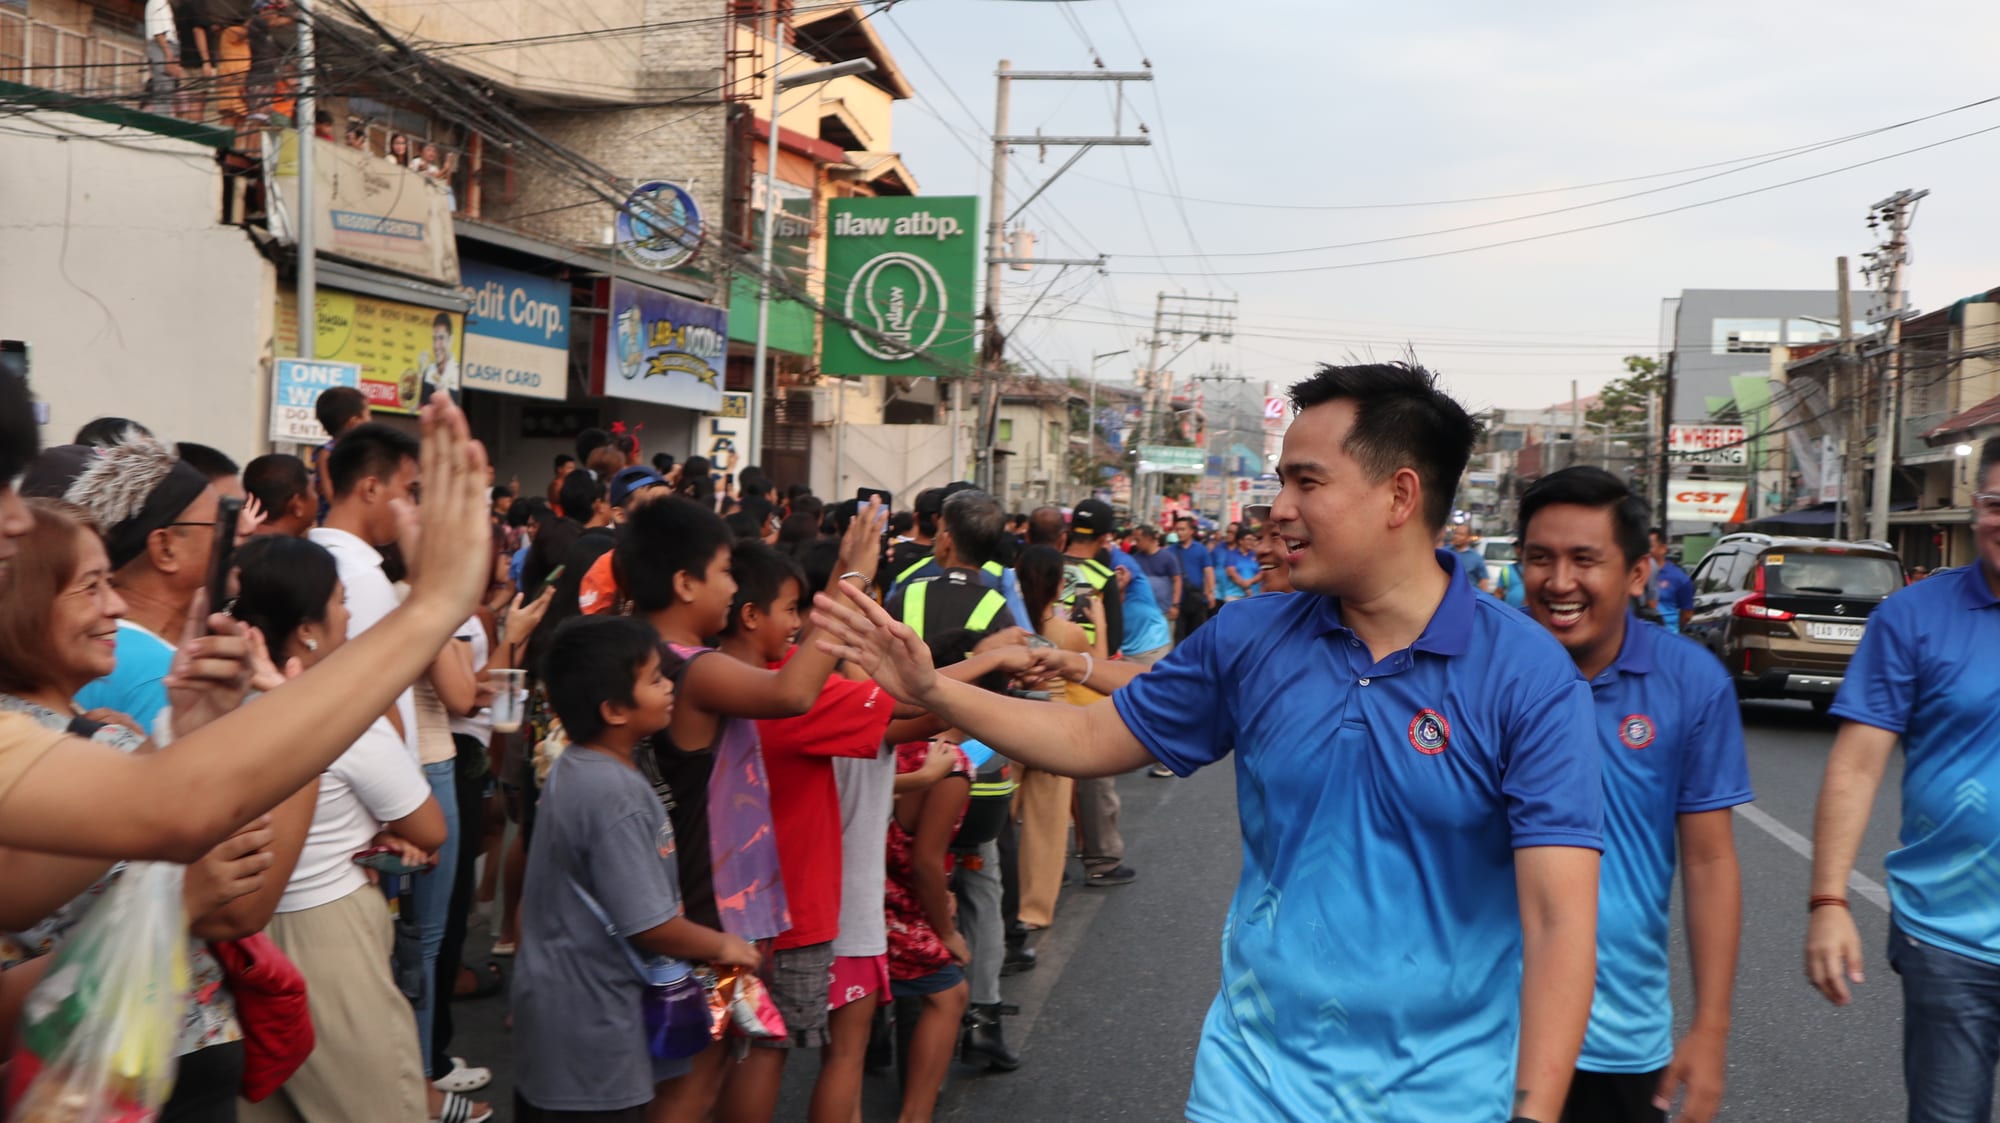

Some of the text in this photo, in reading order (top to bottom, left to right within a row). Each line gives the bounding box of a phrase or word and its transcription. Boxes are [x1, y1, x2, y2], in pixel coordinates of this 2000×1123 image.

[383, 220, 418, 239] CENTER
[835, 211, 964, 242] ilaw atbp.
[456, 281, 506, 321] edit
[509, 287, 564, 340] Corp.
[291, 364, 343, 386] ONE
[465, 362, 542, 388] CASH CARD
[286, 408, 308, 421] DO
[289, 423, 328, 437] ENT
[1676, 491, 1731, 504] CST
